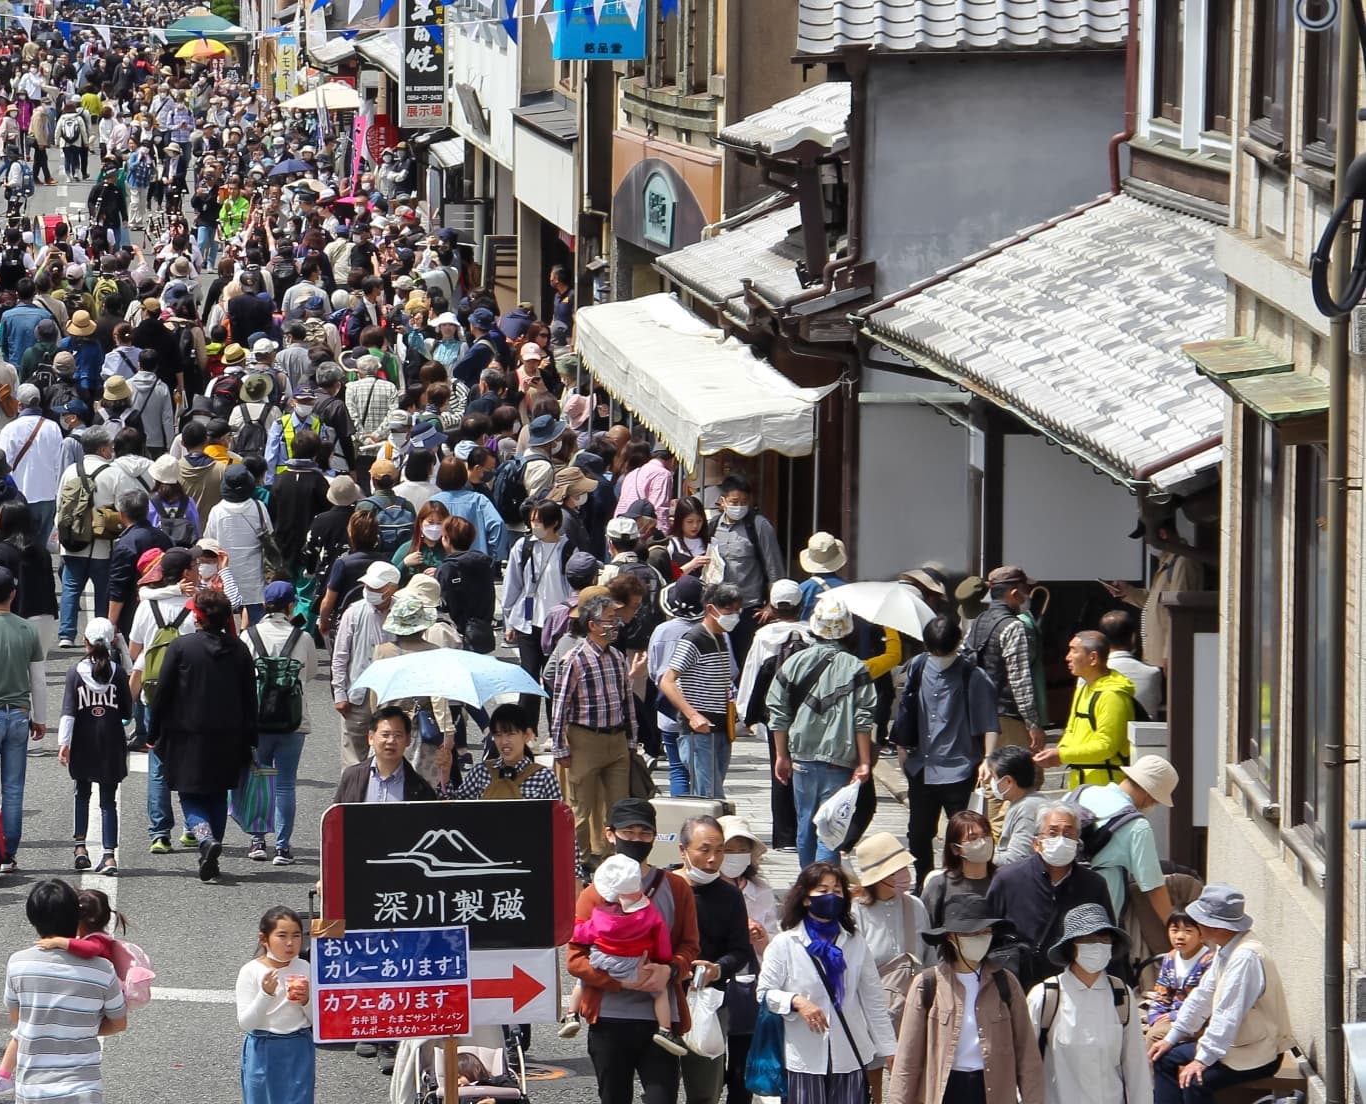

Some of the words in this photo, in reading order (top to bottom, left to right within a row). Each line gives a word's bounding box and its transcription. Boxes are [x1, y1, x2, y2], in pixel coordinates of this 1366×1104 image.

[281, 46, 292, 101] レモネード
[407, 105, 443, 117] 展示場
[77, 683, 119, 711] NIKE
[373, 888, 526, 924] 深川製磁
[324, 938, 399, 957] おいしい
[324, 990, 449, 1011] カフェあります
